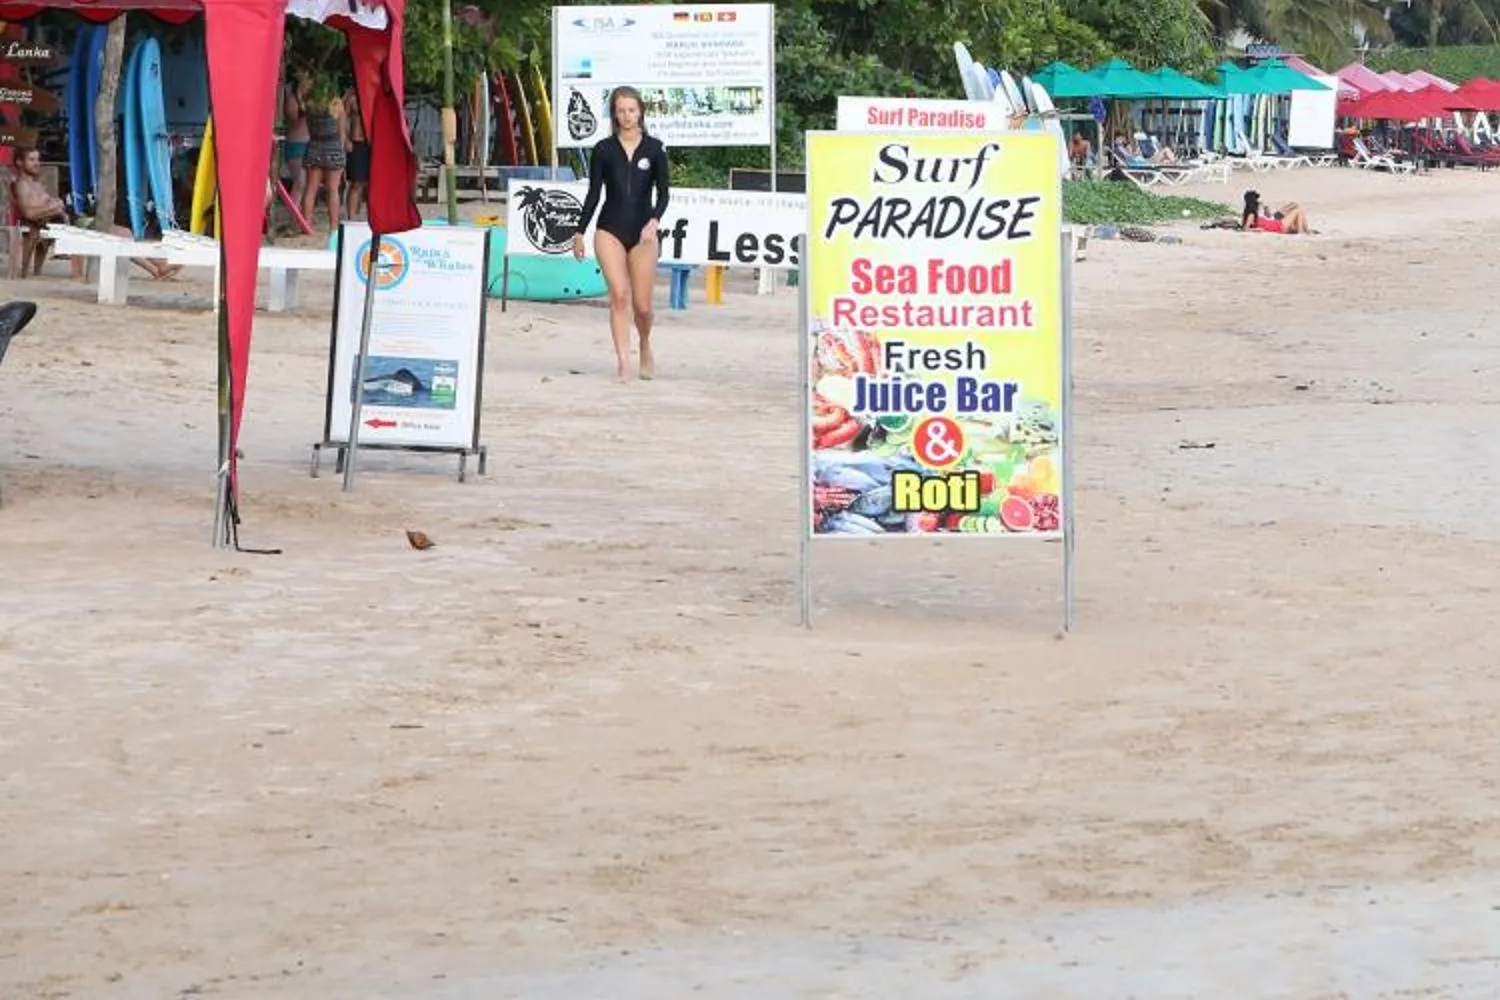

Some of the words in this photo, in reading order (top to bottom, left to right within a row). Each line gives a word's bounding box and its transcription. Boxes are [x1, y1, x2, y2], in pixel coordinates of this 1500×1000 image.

[6, 41, 51, 58] Lanka
[867, 106, 903, 125] Surf
[907, 108, 986, 129] Paradise
[872, 143, 1000, 191] Surf
[825, 195, 1041, 241] PARADISE
[851, 258, 918, 295] Sea
[927, 258, 1012, 295] Food
[833, 298, 1032, 328] Restaurant
[885, 341, 986, 370] Fresh
[853, 376, 947, 413] Juice
[957, 376, 1019, 413] Bar
[925, 420, 959, 462] &
[892, 470, 981, 513] Roti
